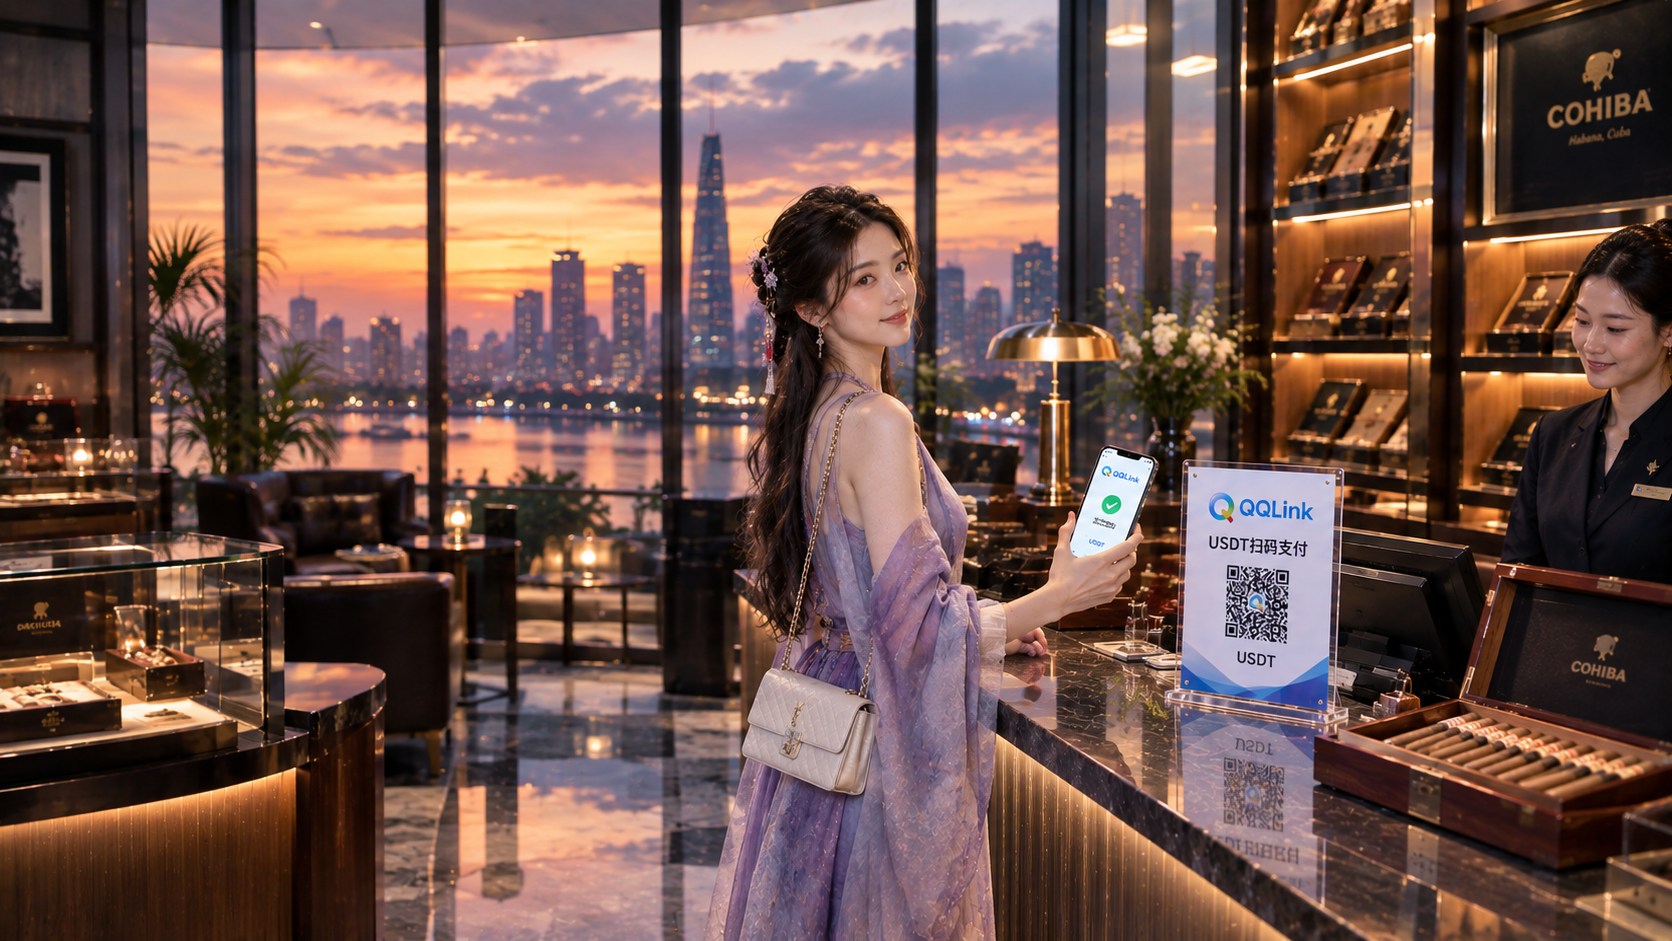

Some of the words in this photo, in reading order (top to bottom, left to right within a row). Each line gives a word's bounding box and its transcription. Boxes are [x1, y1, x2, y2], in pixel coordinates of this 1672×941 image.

[1548, 89, 1653, 128] COHIBA
[1607, 127, 1631, 139] Cuba
[1239, 498, 1314, 521] QQLink
[1208, 535, 1308, 557] USDT扫码支付
[1237, 650, 1276, 668] USDT
[1570, 660, 1627, 683] COHIBA
